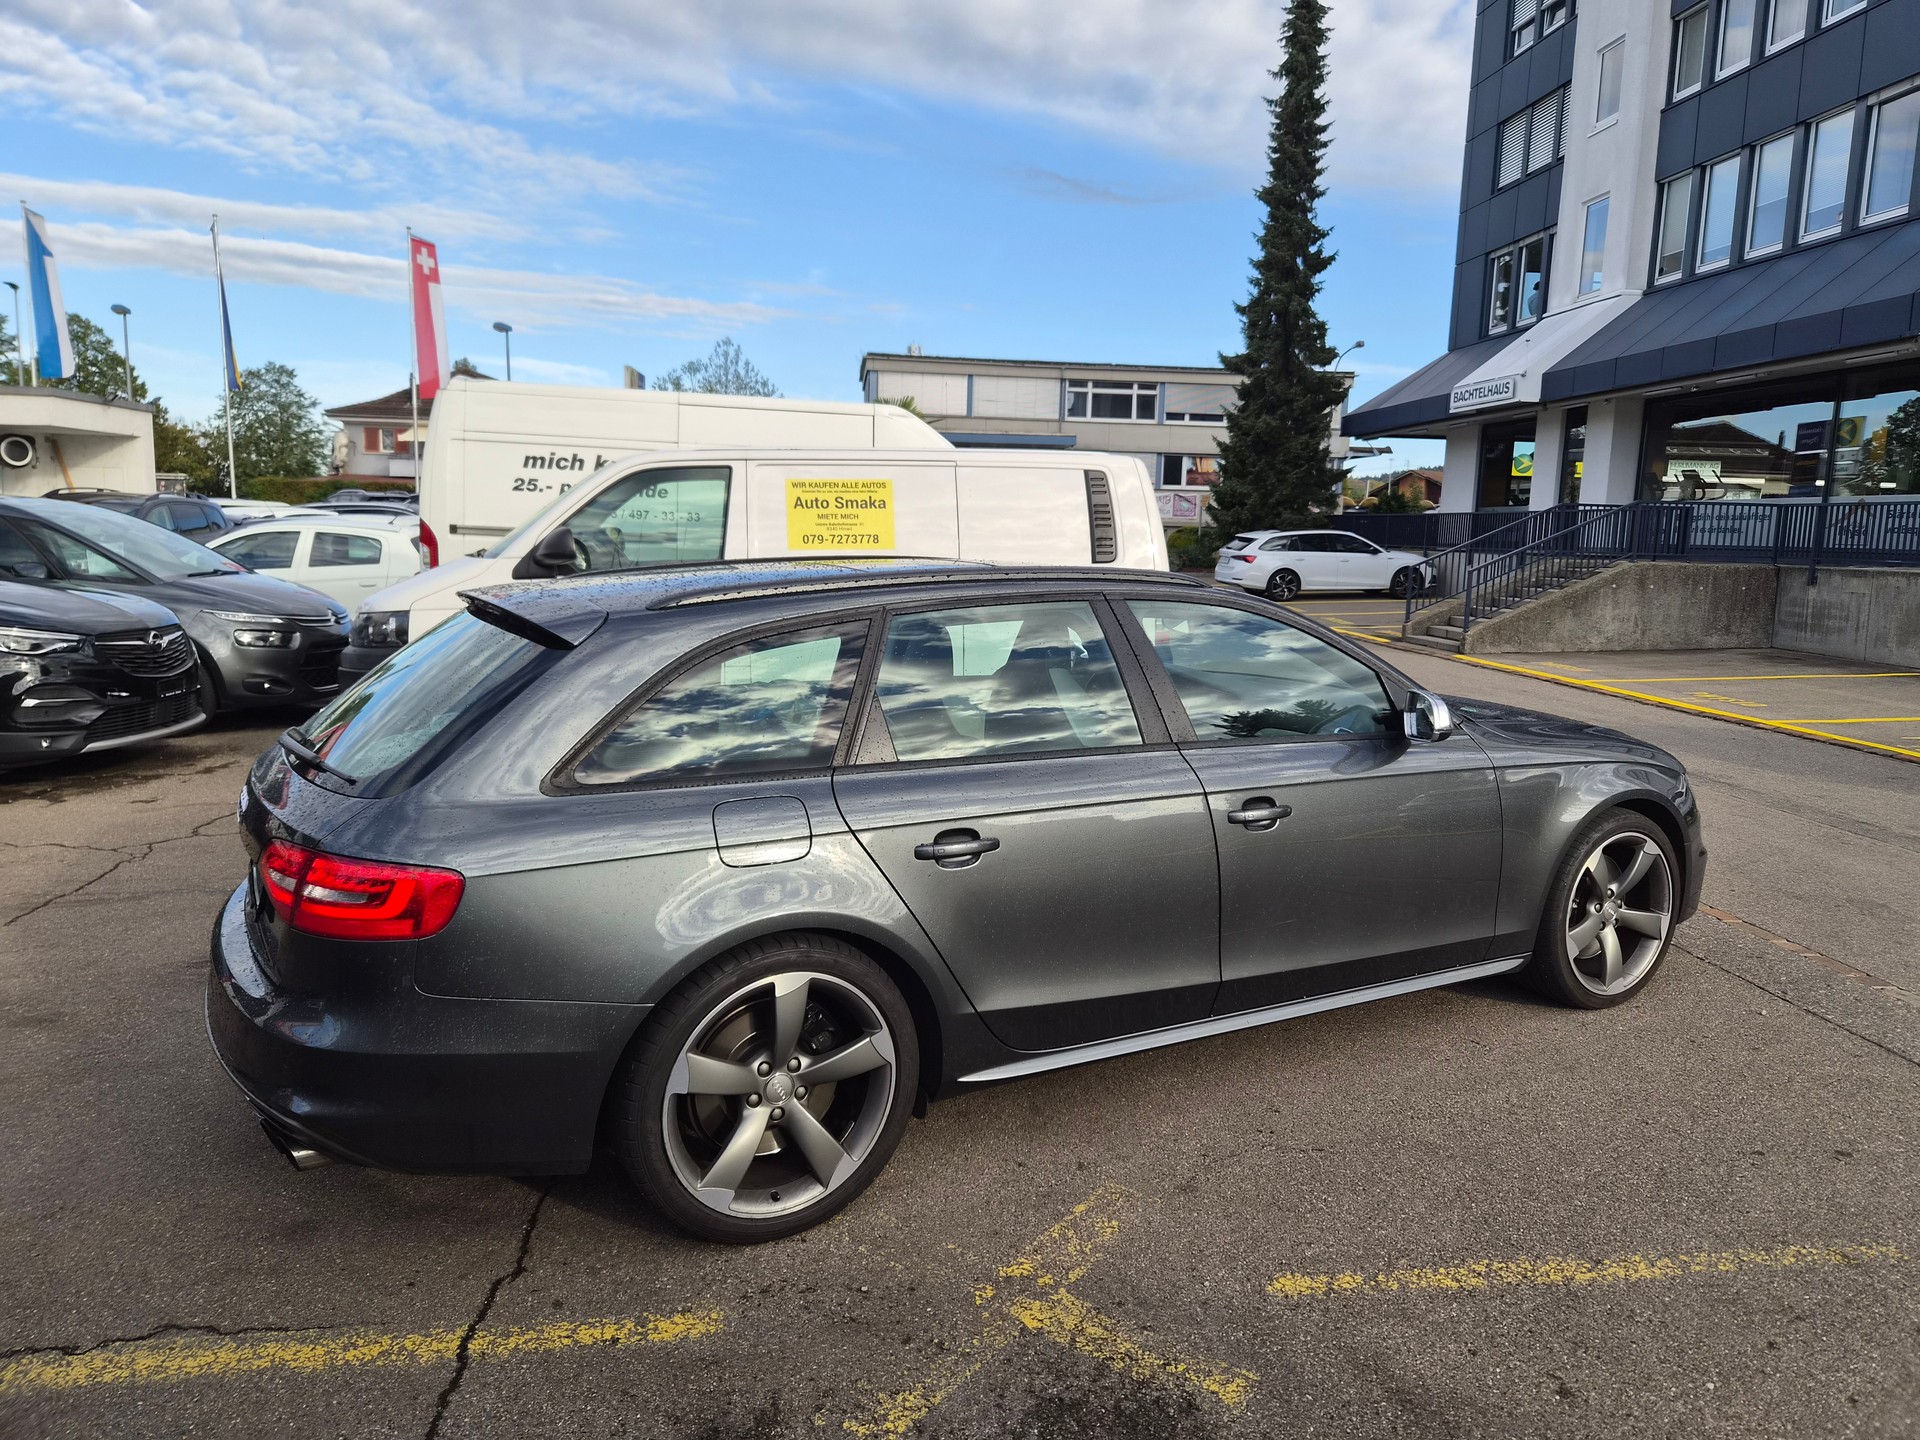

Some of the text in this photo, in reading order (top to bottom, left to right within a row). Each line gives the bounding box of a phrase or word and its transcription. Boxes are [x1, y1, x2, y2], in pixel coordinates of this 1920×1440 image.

[1453, 381, 1511, 403] BACHTELHAUS
[523, 452, 585, 471] mich
[512, 477, 552, 493] 25.-
[791, 481, 887, 489] WIR KAUFEN ALLE AUTOS
[793, 495, 887, 510] Auto Smaka
[628, 510, 650, 520] 497
[661, 511, 675, 521] 33
[686, 512, 701, 523] 33
[802, 534, 880, 545] 079-7273778
